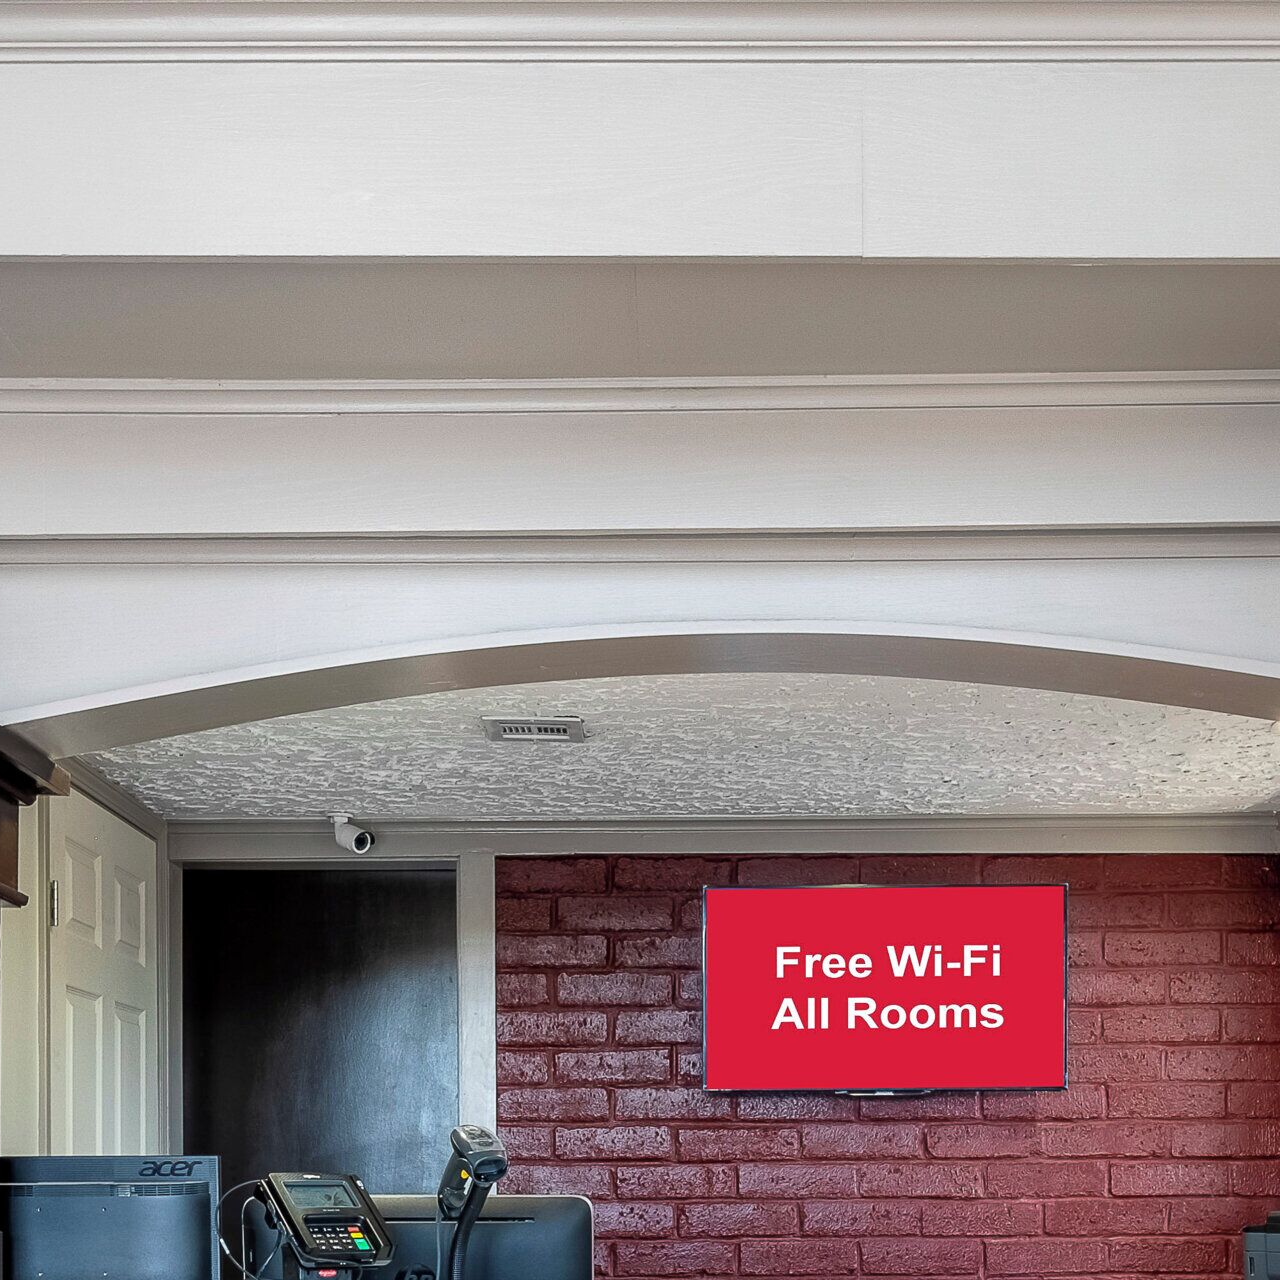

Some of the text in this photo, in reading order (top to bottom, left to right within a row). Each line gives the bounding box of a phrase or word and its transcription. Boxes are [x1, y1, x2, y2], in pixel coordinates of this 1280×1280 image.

[776, 944, 1001, 979] Free Wi-Fi
[771, 996, 1005, 1030] All Rooms
[138, 1160, 203, 1177] acer
